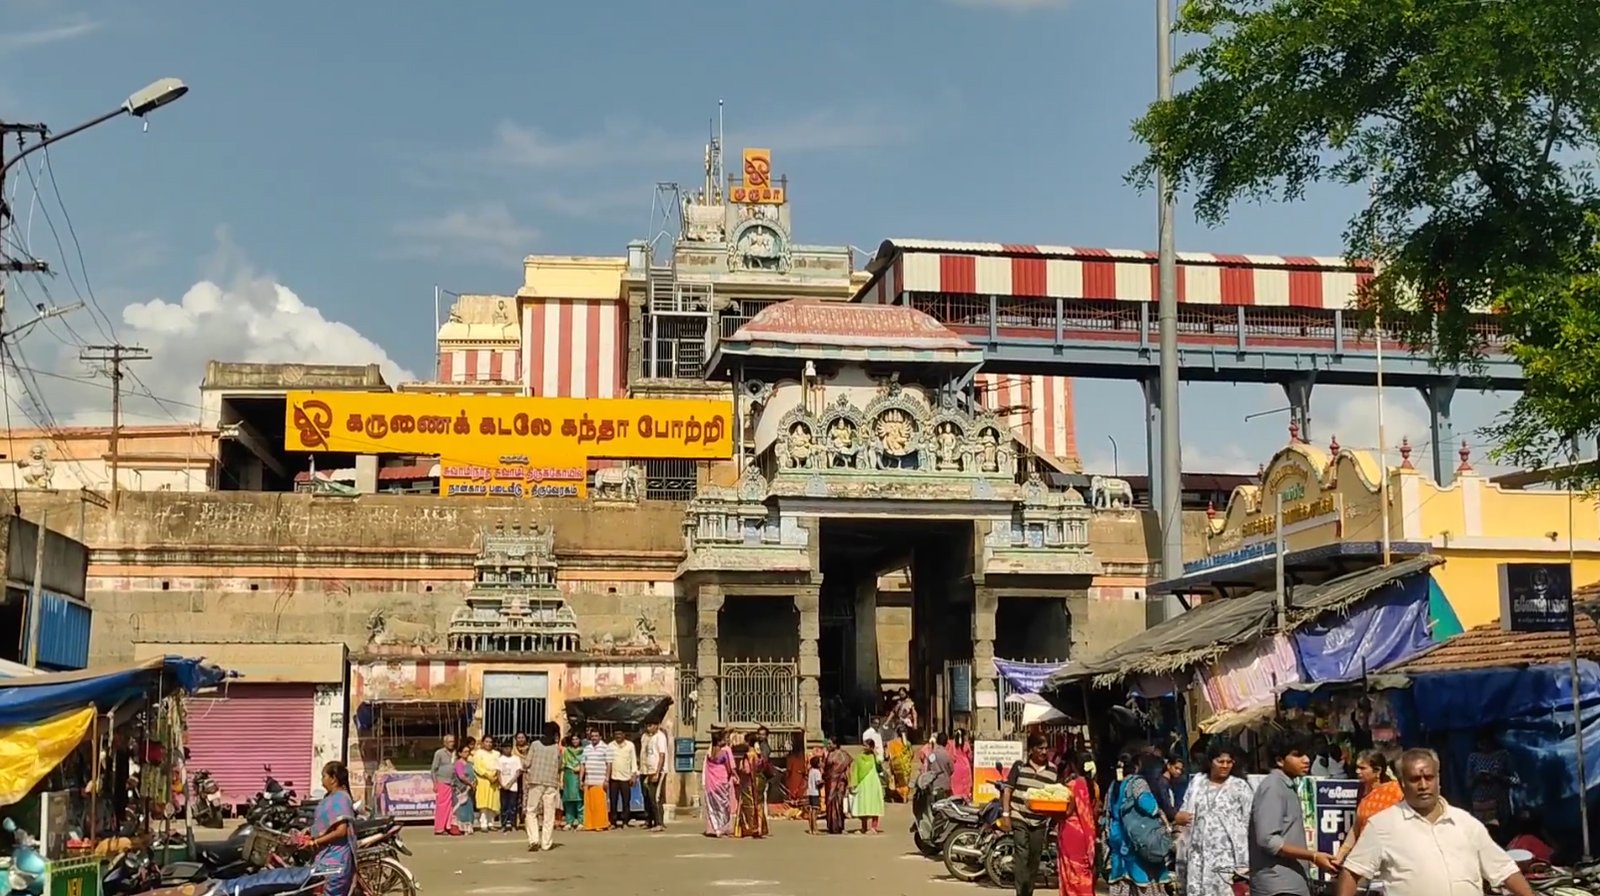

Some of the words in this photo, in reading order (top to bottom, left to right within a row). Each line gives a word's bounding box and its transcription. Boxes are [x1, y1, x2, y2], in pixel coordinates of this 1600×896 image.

[346, 408, 470, 439] கருணைக்
[479, 412, 552, 437] கடலே
[561, 413, 629, 445] கந்தா
[638, 414, 724, 446] போற்றி
